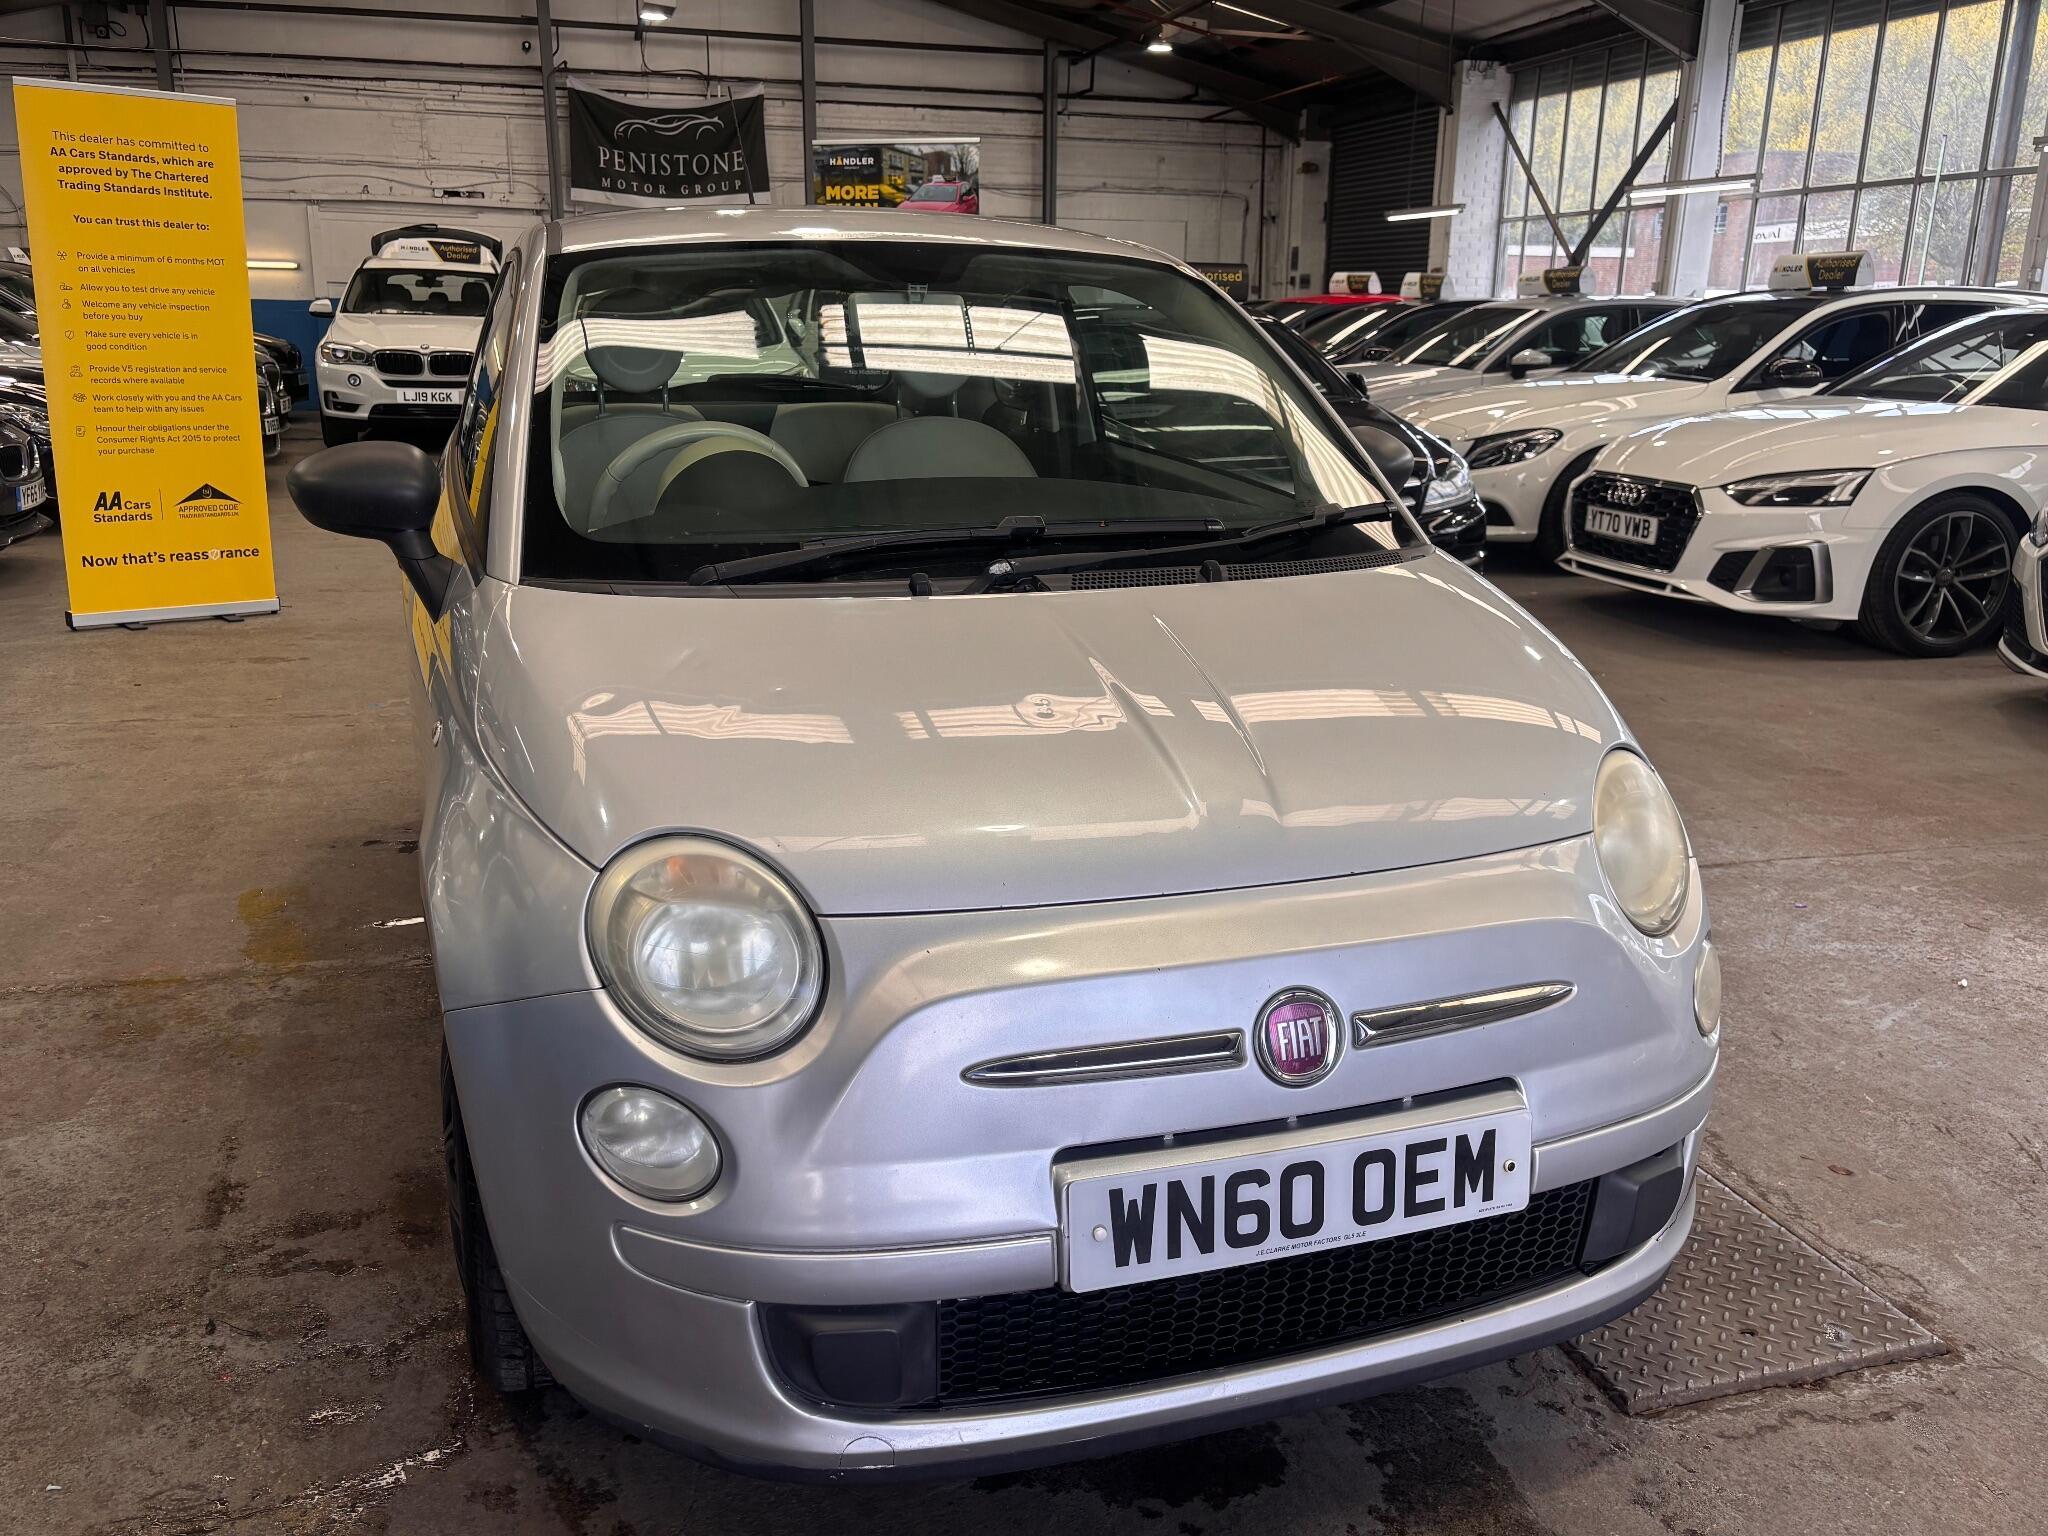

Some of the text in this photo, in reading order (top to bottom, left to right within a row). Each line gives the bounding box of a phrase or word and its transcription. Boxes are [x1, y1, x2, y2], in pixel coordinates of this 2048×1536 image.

[52, 131, 209, 152] This dealer has committed to
[50, 147, 214, 168] AA Cars Standards, which are
[598, 146, 745, 176] PENISTONE
[58, 165, 208, 183] approved by The Chartered
[57, 180, 213, 199] Trading Standards Institute.
[602, 177, 742, 195] MOTOR GROUP
[825, 184, 880, 200] MORE
[73, 215, 210, 230] You can trust this dealer to:
[440, 244, 478, 254] Authorised
[77, 252, 108, 261] Provide
[117, 255, 155, 263] minimum
[174, 257, 205, 265] months
[446, 252, 471, 260] Dealer
[102, 266, 135, 274] vehicles
[80, 283, 103, 292] Allow
[105, 285, 119, 293] you
[149, 286, 169, 294] drive
[171, 288, 186, 296] any
[187, 288, 215, 296] vehicle
[82, 300, 210, 312] Welcome any vehicle inspection
[83, 312, 109, 320] before
[128, 314, 143, 322] buy
[85, 330, 107, 338] Make
[128, 332, 150, 340] every
[182, 332, 189, 340] is
[191, 332, 198, 340] in
[86, 343, 147, 352] good condition
[89, 365, 120, 373] Provide
[122, 365, 133, 373] V5
[135, 365, 181, 374] registration
[116, 394, 144, 402] closely
[403, 391, 453, 402] LJ19 KGK
[126, 406, 144, 414] help
[127, 424, 146, 432] their
[147, 424, 191, 432] obligations
[96, 436, 138, 444] Consumer
[140, 435, 165, 444] Rights
[213, 435, 240, 443] protect
[98, 447, 154, 456] your purchase
[93, 491, 151, 511] AA Cars
[93, 512, 153, 523] Standards
[1591, 509, 1651, 538] YT70 VWB
[81, 556, 118, 568] Now
[1277, 1017, 1322, 1060] FIAT
[1108, 1128, 1497, 1268] WN60 OEM
[1291, 1240, 1313, 1250] MOTOR
[1313, 1235, 1341, 1247] FACTORS
